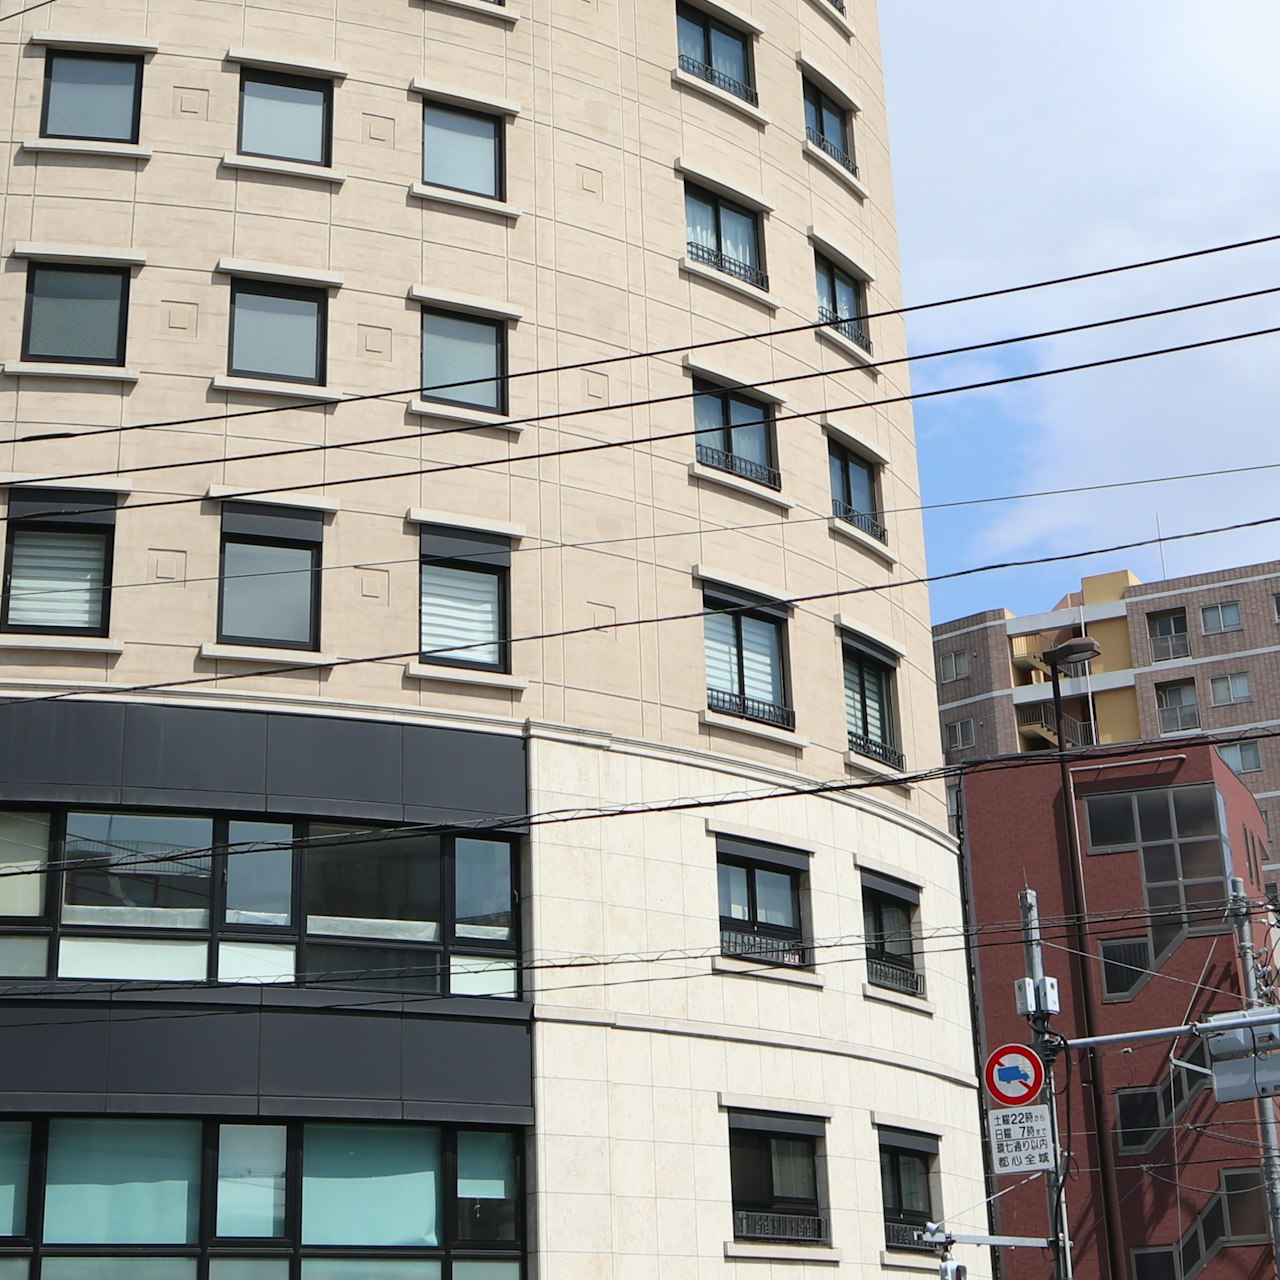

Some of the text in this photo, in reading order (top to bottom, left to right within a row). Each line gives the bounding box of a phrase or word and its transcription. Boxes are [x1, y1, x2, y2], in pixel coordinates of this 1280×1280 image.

[994, 1112, 1045, 1126] 土曜22時から
[997, 1139, 1048, 1154] 環七通り以内
[999, 1152, 1050, 1168] 都心全域
